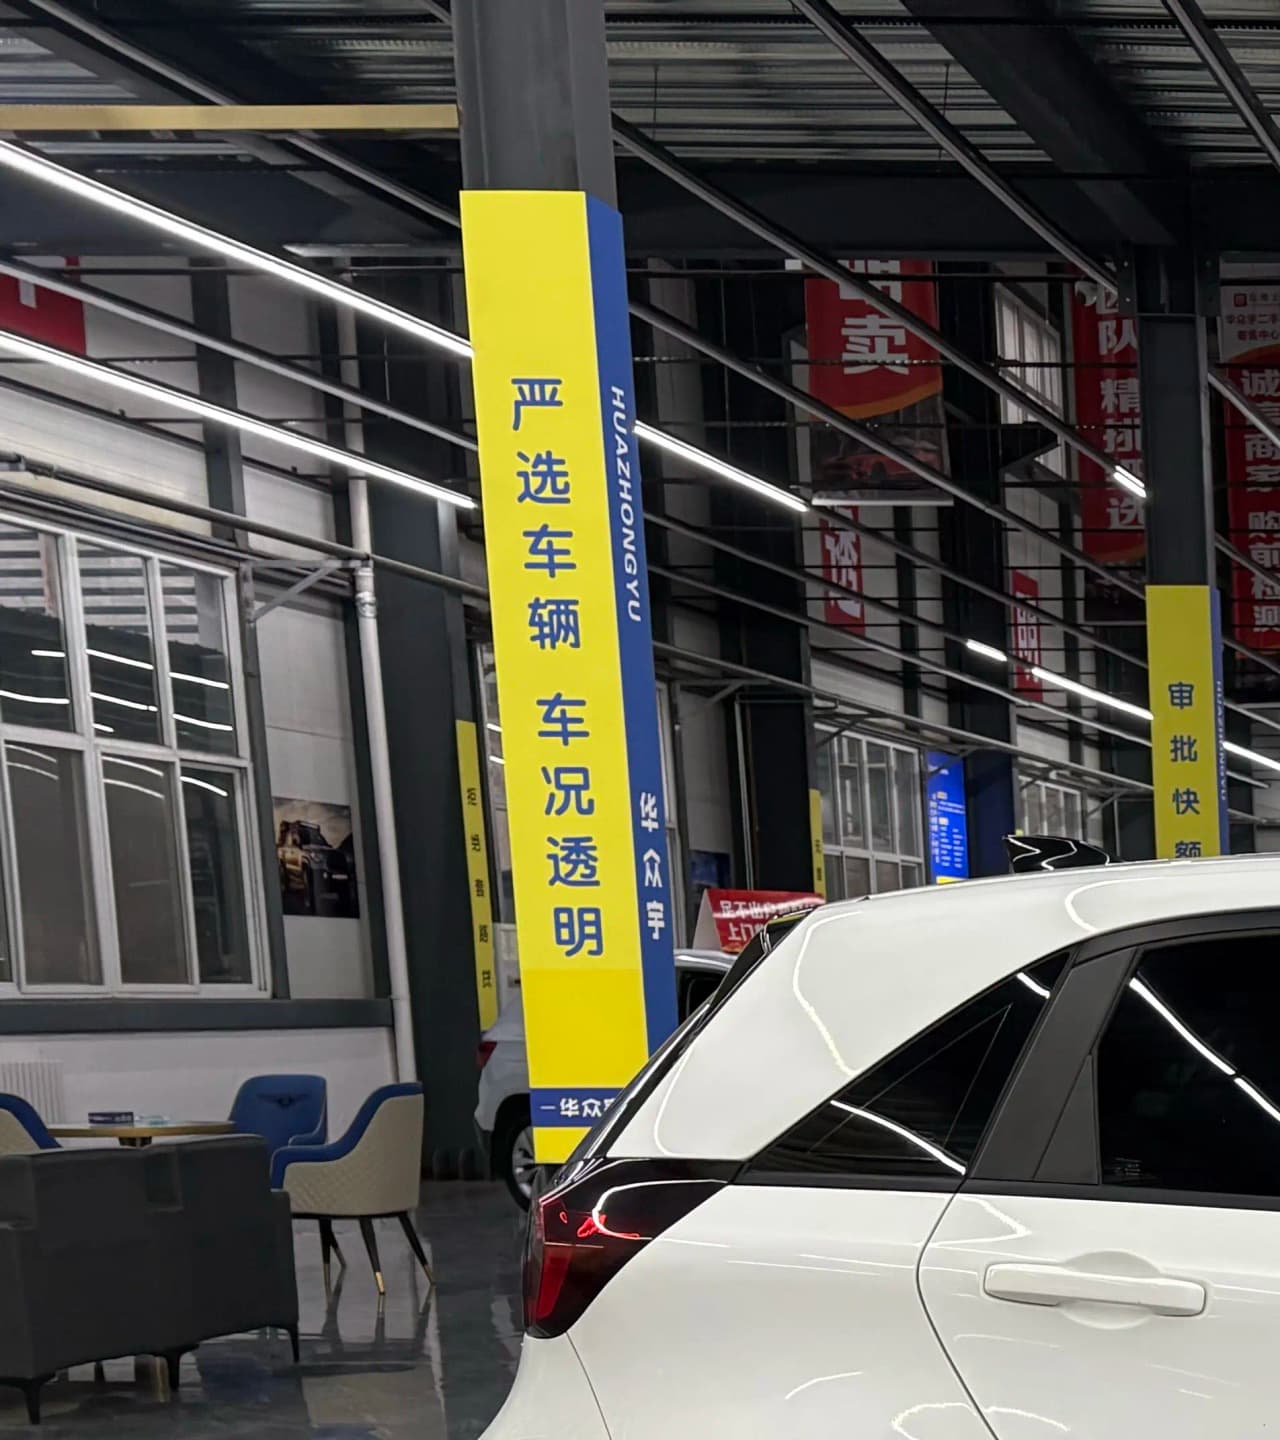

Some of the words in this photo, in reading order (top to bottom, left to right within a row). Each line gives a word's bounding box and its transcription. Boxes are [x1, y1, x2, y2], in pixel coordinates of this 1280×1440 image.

[511, 377, 581, 651] 严选车辆
[610, 384, 641, 623] HUAZHONGYU
[1099, 377, 1147, 530] 精挑选
[536, 692, 604, 958] 车况透明
[639, 791, 665, 941] 华众宇
